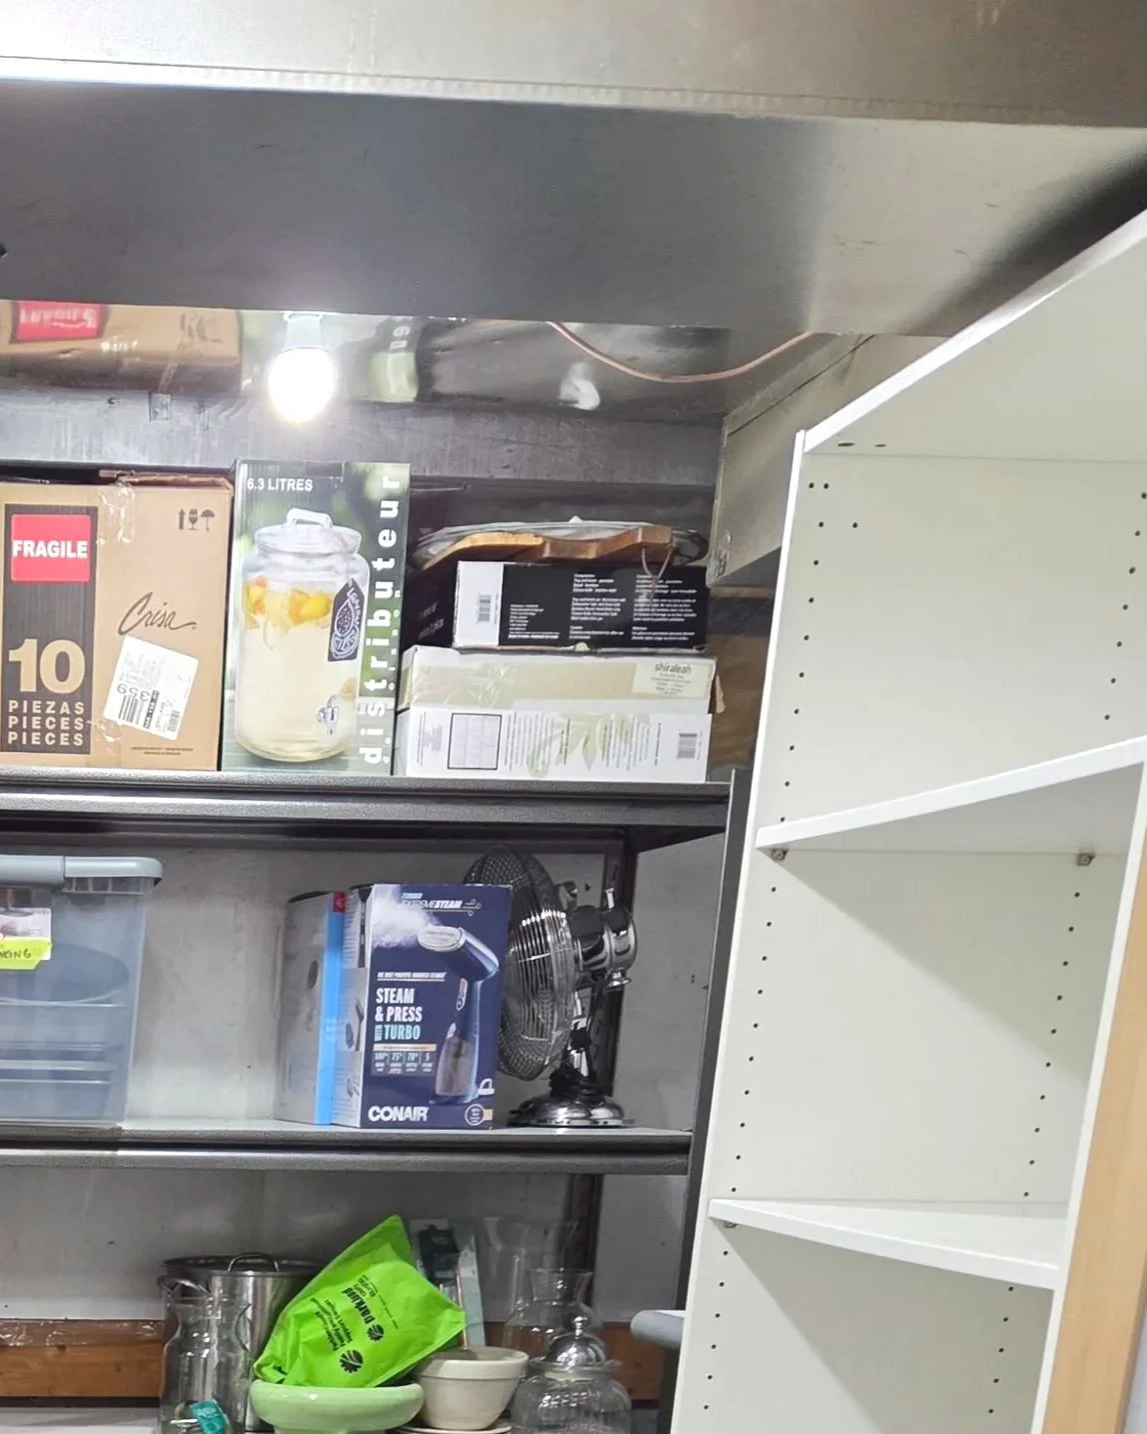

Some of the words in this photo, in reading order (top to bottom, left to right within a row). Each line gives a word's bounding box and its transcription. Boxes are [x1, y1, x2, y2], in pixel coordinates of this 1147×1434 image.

[246, 477, 265, 491] 6.3
[267, 478, 314, 492] LITRES
[11, 539, 88, 559] FRAGILE
[117, 591, 197, 636] Crisa
[358, 475, 401, 765] distributeur
[8, 638, 86, 695] 10
[7, 699, 85, 715] PIEZAS
[7, 715, 84, 730] PIECES
[6, 731, 84, 747] PIECES
[375, 987, 416, 1004] STEAM
[374, 1005, 384, 1023] &
[385, 1006, 423, 1023] PRESS
[383, 1024, 422, 1041] TURBO
[367, 1105, 430, 1122] CONAIR
